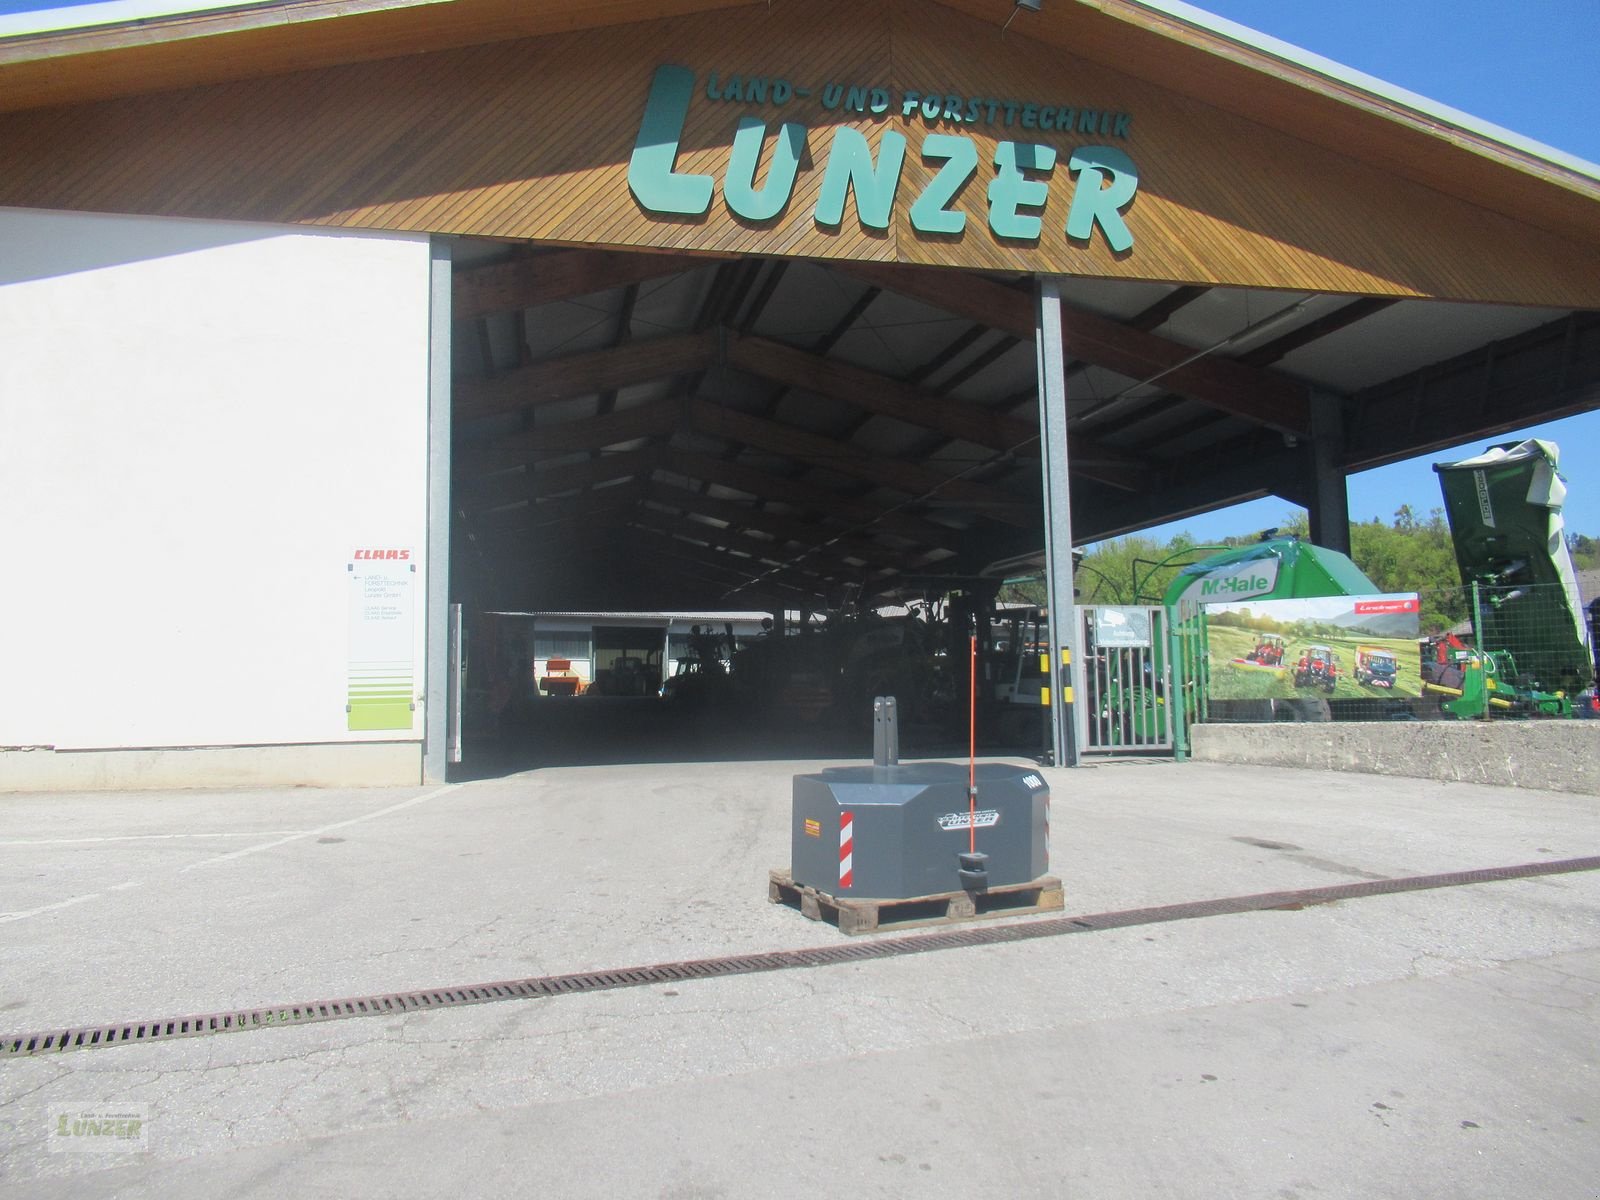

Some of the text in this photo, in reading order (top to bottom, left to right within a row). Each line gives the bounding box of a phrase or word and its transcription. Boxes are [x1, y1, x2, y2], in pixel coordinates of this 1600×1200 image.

[706, 70, 1132, 138] LAND- UND FORSTTECHNIK
[627, 64, 1138, 253] LUNZER
[354, 550, 410, 560] CLAAS
